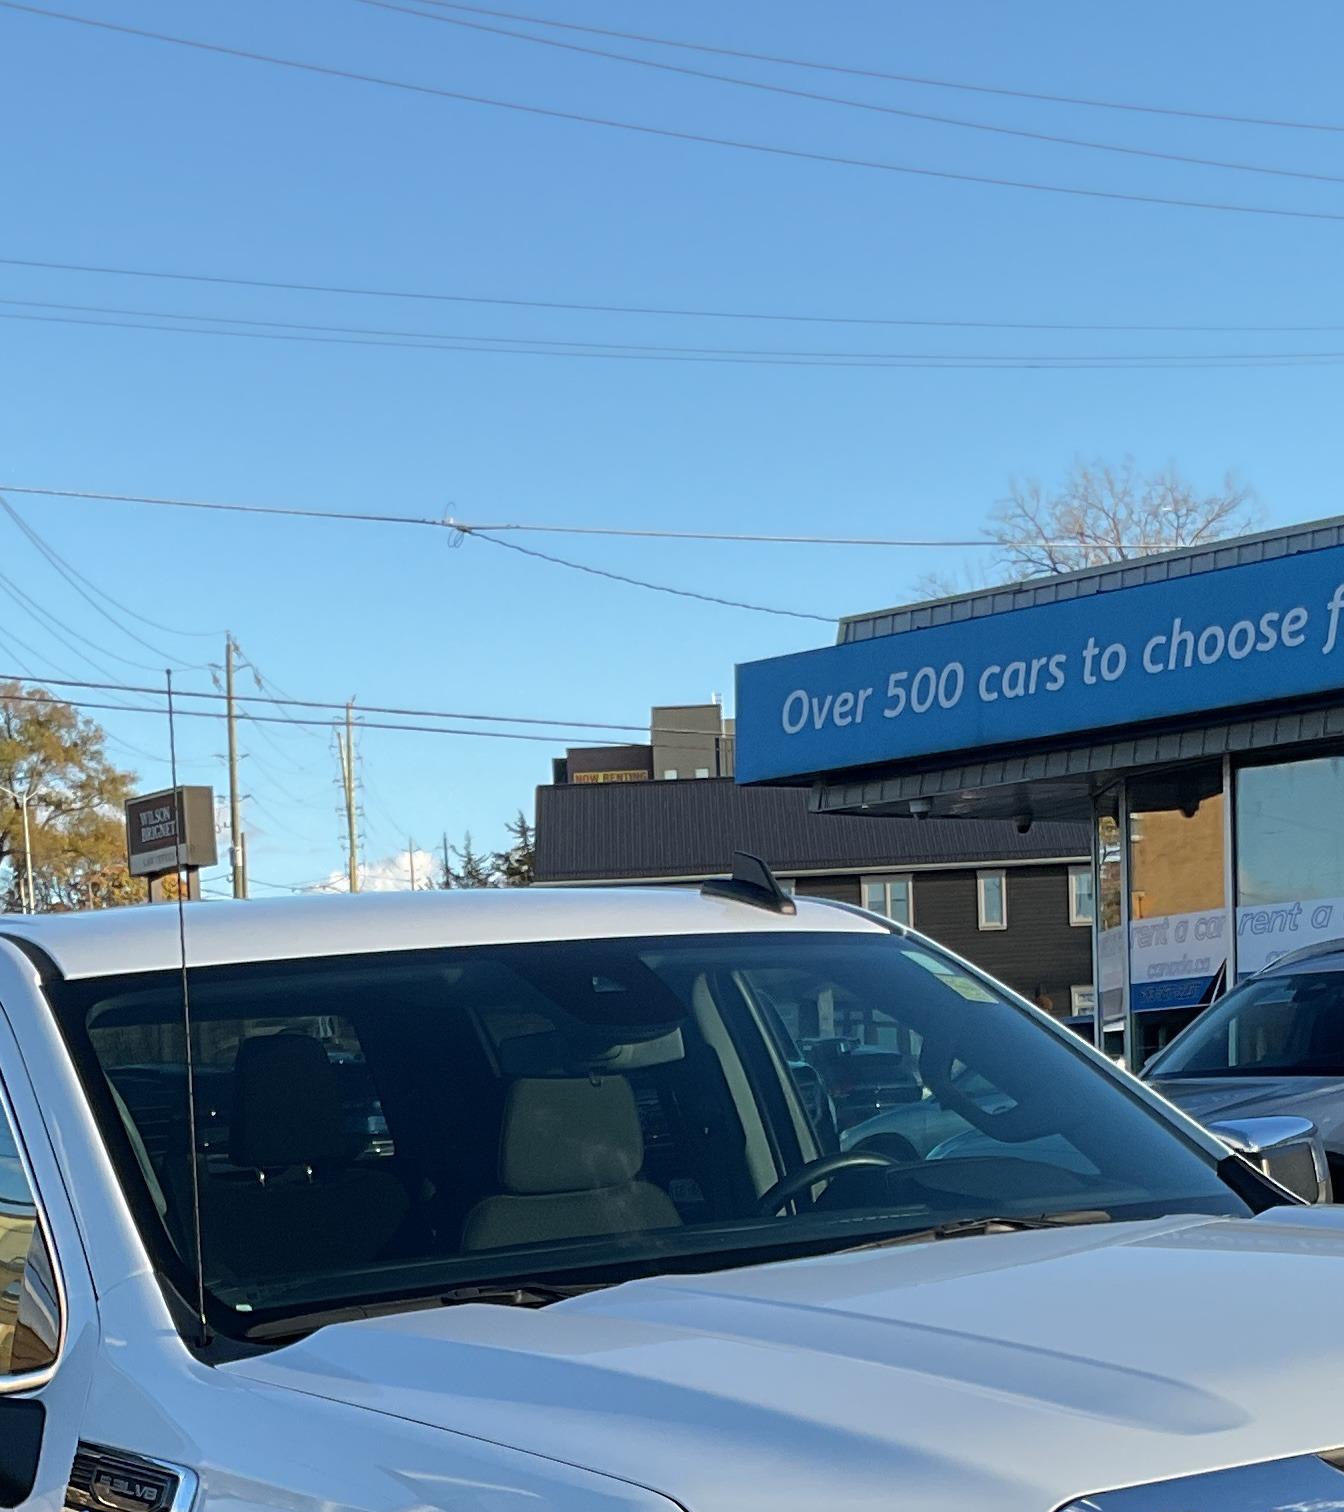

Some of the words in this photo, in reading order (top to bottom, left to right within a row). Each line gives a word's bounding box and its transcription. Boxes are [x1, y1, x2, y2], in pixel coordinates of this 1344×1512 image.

[781, 688, 874, 735] Over
[882, 661, 965, 719] 500
[978, 653, 1067, 702] cars
[1082, 636, 1128, 686] to
[1142, 607, 1309, 674] choose
[1174, 920, 1189, 944] a
[1194, 914, 1227, 942] car
[1238, 901, 1303, 937] rent
[1311, 904, 1334, 930] a
